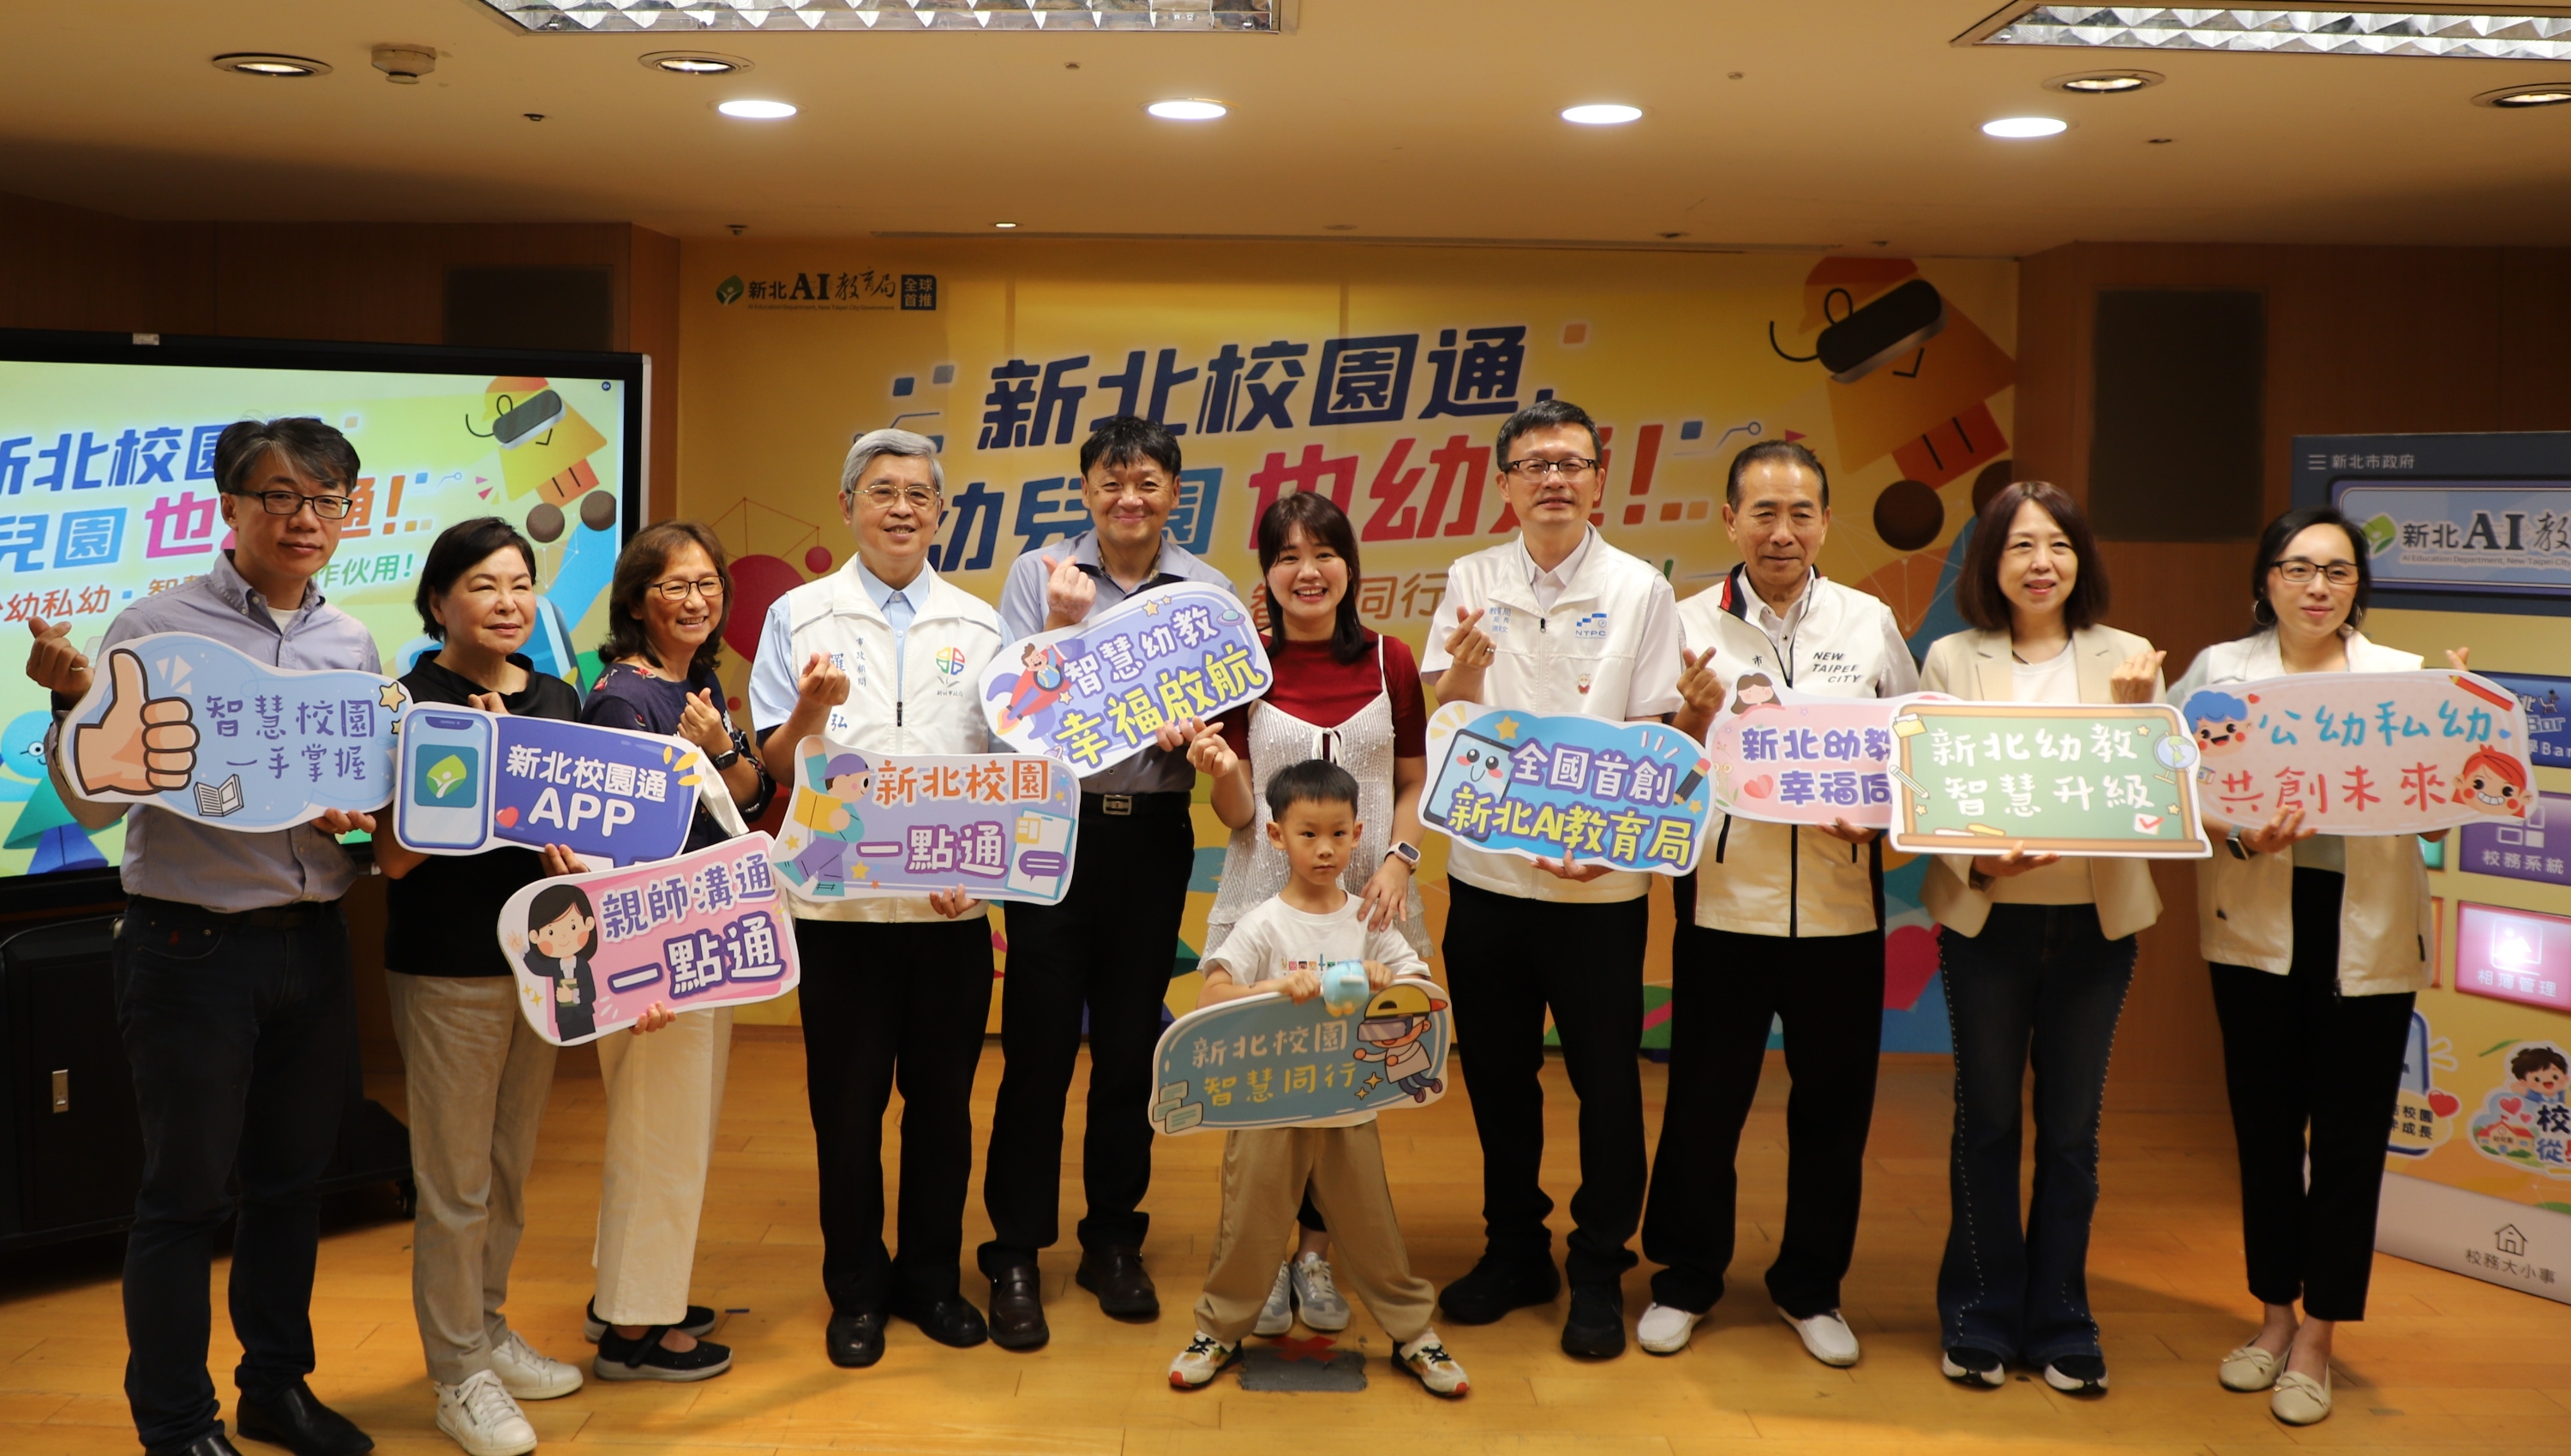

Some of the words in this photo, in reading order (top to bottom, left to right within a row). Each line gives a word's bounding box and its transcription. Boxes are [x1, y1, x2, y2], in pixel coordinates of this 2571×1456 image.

[748, 266, 896, 301] 新北AI教育局
[904, 278, 932, 292] 全球
[904, 292, 932, 307] 首推
[2332, 453, 2415, 470] 新北市政府
[1249, 424, 1663, 550] 也幼!
[2454, 556, 2505, 566] Department,
[2527, 557, 2553, 566] Taipei
[0, 584, 111, 622] 幼私幼
[1063, 607, 1219, 697] 智慧幼教
[1813, 651, 1845, 661] NEW
[1813, 663, 1858, 673] TAIPEI
[1827, 674, 1862, 683] CITY
[206, 694, 375, 740] 智慧校園
[1055, 643, 1265, 765] 幸福啟航
[2258, 698, 2492, 746] 公幼私幼
[225, 743, 366, 782] 一手掌握
[1741, 728, 1891, 762] 新北幼教
[1930, 722, 2138, 767] 新北幼教
[506, 744, 668, 804] 新北校園通
[875, 759, 1049, 806] 新北校園
[1513, 742, 1674, 804] 全國首創
[1944, 773, 2155, 818] 智慧升級
[2220, 761, 2446, 815] 共創未來
[527, 787, 636, 837] APP
[1447, 785, 1694, 867] 新北AI教育局
[859, 824, 1005, 876] 一點通
[2483, 850, 2564, 875] 校務系統
[602, 853, 776, 940] 親師溝通
[612, 914, 782, 996] 一點通
[1191, 1019, 1348, 1069] 新北校園
[1203, 1061, 1357, 1107] 智慧同行
[2466, 1248, 2556, 1285] 校務大小事
